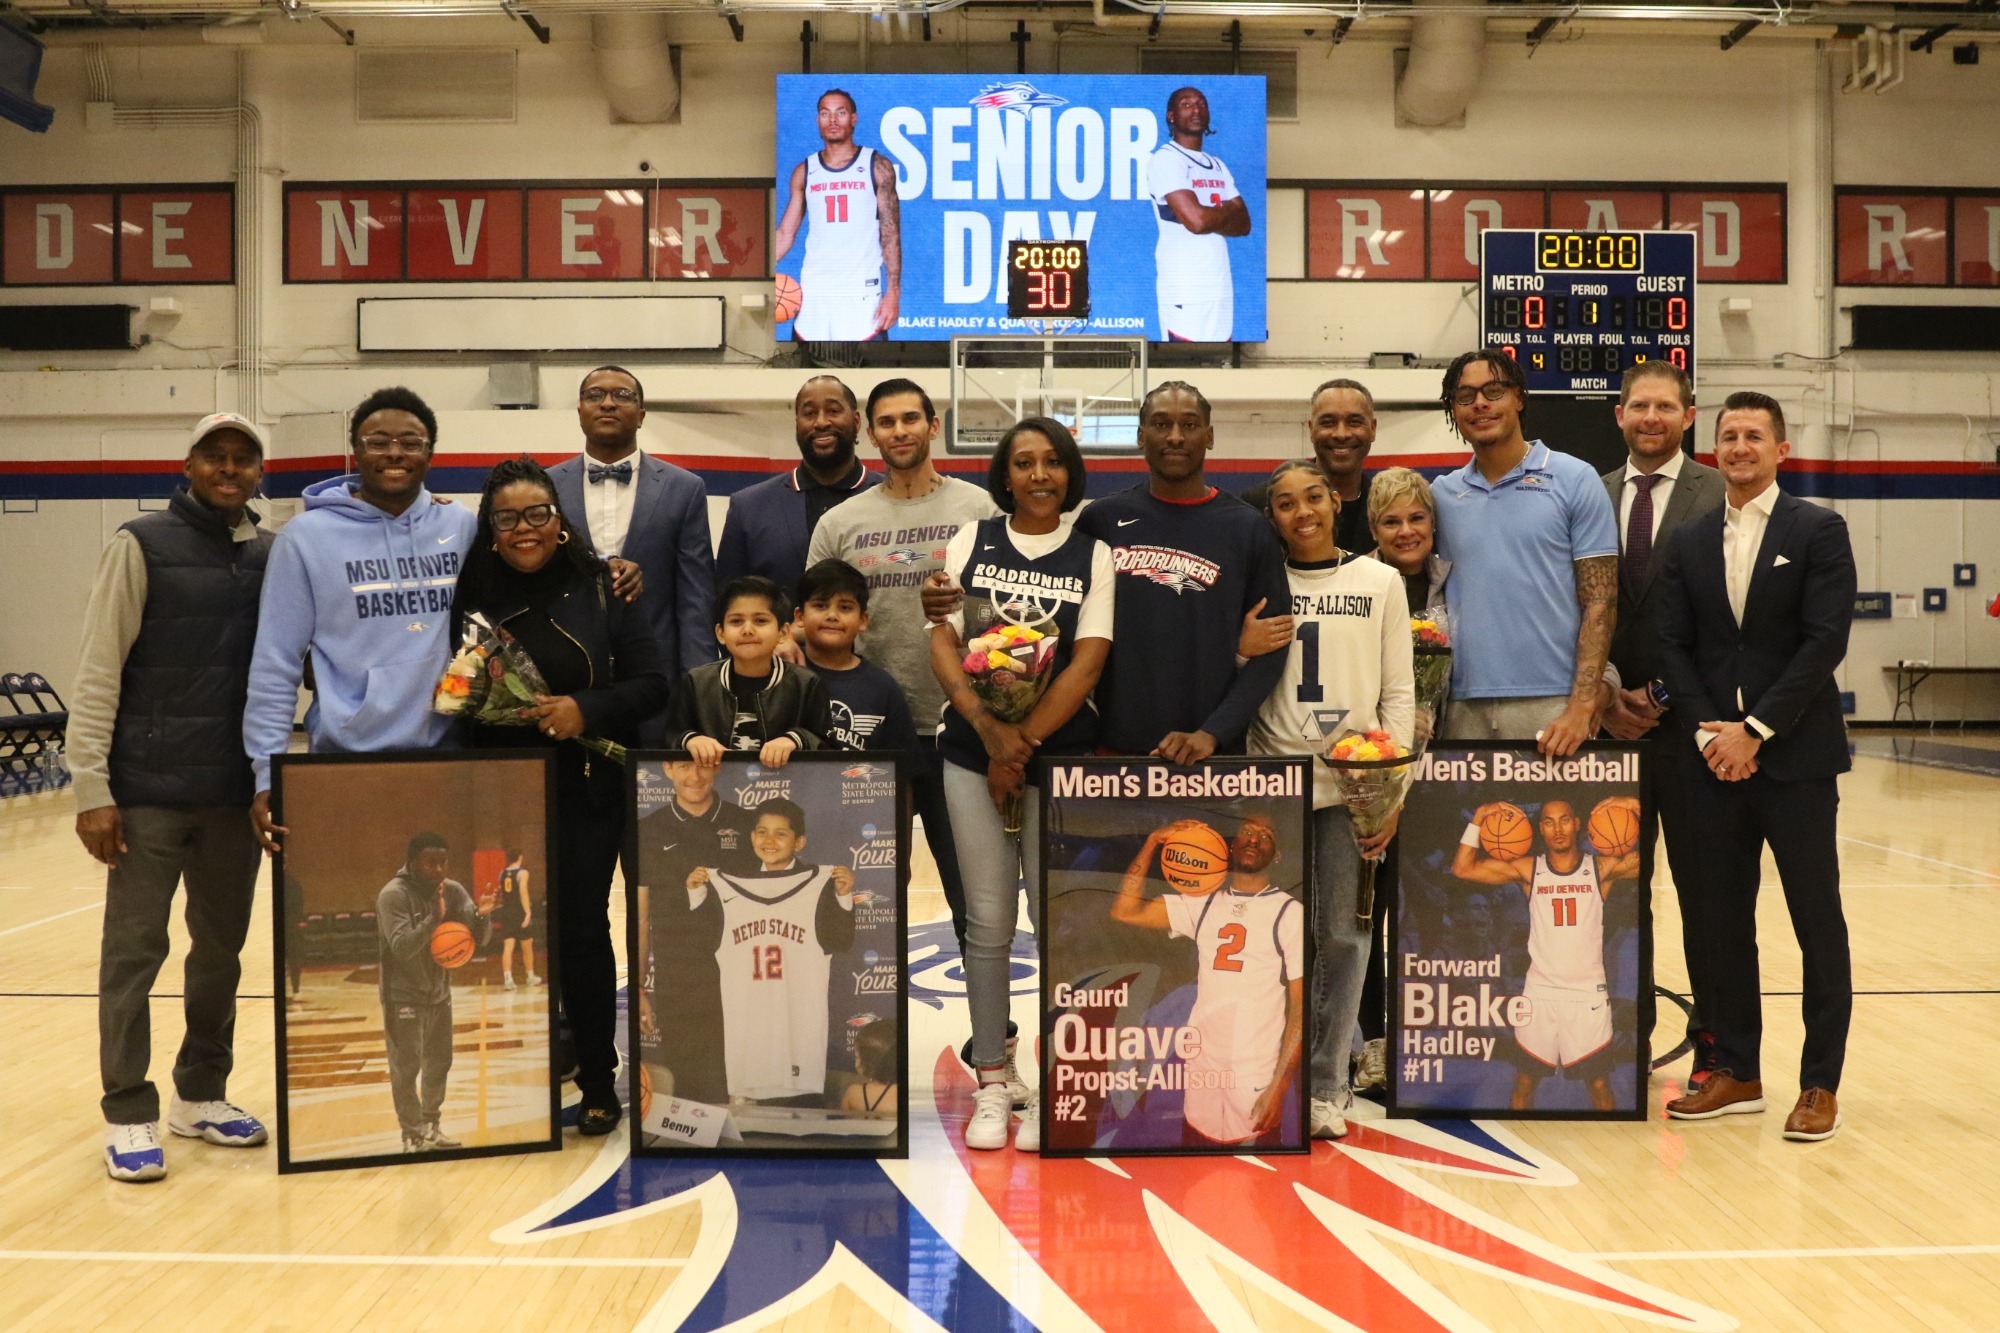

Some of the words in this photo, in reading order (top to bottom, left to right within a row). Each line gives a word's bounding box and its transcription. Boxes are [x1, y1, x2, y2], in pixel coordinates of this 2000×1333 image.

[880, 107, 1158, 200] SENIOR
[810, 182, 827, 193] MSU
[829, 181, 866, 190] DENVER
[825, 195, 848, 223] 11
[1015, 247, 1081, 269] 20:00
[1542, 235, 1637, 269] 20:00
[1028, 271, 1071, 309] 30
[1493, 275, 1544, 291] METRO
[1571, 284, 1608, 295] PERIOD
[1637, 276, 1686, 292] GUEST
[898, 317, 935, 327] BLAKE
[938, 317, 984, 327] HADLEY
[986, 317, 997, 327] &
[1525, 296, 1544, 328] 0
[1592, 302, 1597, 324] 1
[1668, 298, 1687, 329] 0
[1488, 333, 1520, 344] FOULS
[1526, 335, 1546, 343] T.O.L.
[1554, 334, 1593, 344] PLAYER
[1599, 334, 1625, 345] FOUL
[1631, 336, 1651, 344] T.O.L.
[1658, 334, 1690, 345] FOULS
[1533, 354, 1543, 369] 4
[1571, 378, 1607, 389] MATCH
[855, 531, 892, 550] MSU
[895, 525, 959, 545] DENVER
[345, 559, 390, 584] MSU
[397, 552, 459, 580] DENVER
[974, 563, 1084, 592] ROADRUNNER
[1112, 547, 1218, 585] ROADRUNNERS
[356, 586, 457, 619] BASKETBAL
[981, 580, 1073, 600] BASKETBALL
[1296, 622, 1323, 702] 1
[1493, 752, 1640, 782] Basketball
[755, 780, 780, 788] MAKE
[781, 779, 791, 788] IT
[1053, 766, 1141, 798] Men's
[1148, 766, 1302, 797] Basketball
[1165, 848, 1209, 870] Wilson
[505, 877, 512, 893] 0
[1168, 873, 1200, 888] NCAA
[1537, 884, 1554, 894] MSU
[1556, 884, 1593, 893] DENVER
[1552, 898, 1577, 926] 11
[732, 918, 767, 945] METRO
[769, 918, 806, 945] STATE
[1212, 923, 1247, 972] 2
[752, 944, 783, 981] 12
[1404, 953, 1501, 978] Forward
[1054, 982, 1129, 1008] Gaurd
[1403, 982, 1534, 1028] Blake
[1053, 1013, 1203, 1061] Quave
[1403, 1029, 1496, 1062] Hadley
[1056, 1063, 1236, 1099] Propst-Allison
[1403, 1058, 1444, 1083] #11
[1054, 1095, 1088, 1121] #2
[661, 1116, 698, 1138] Benny
